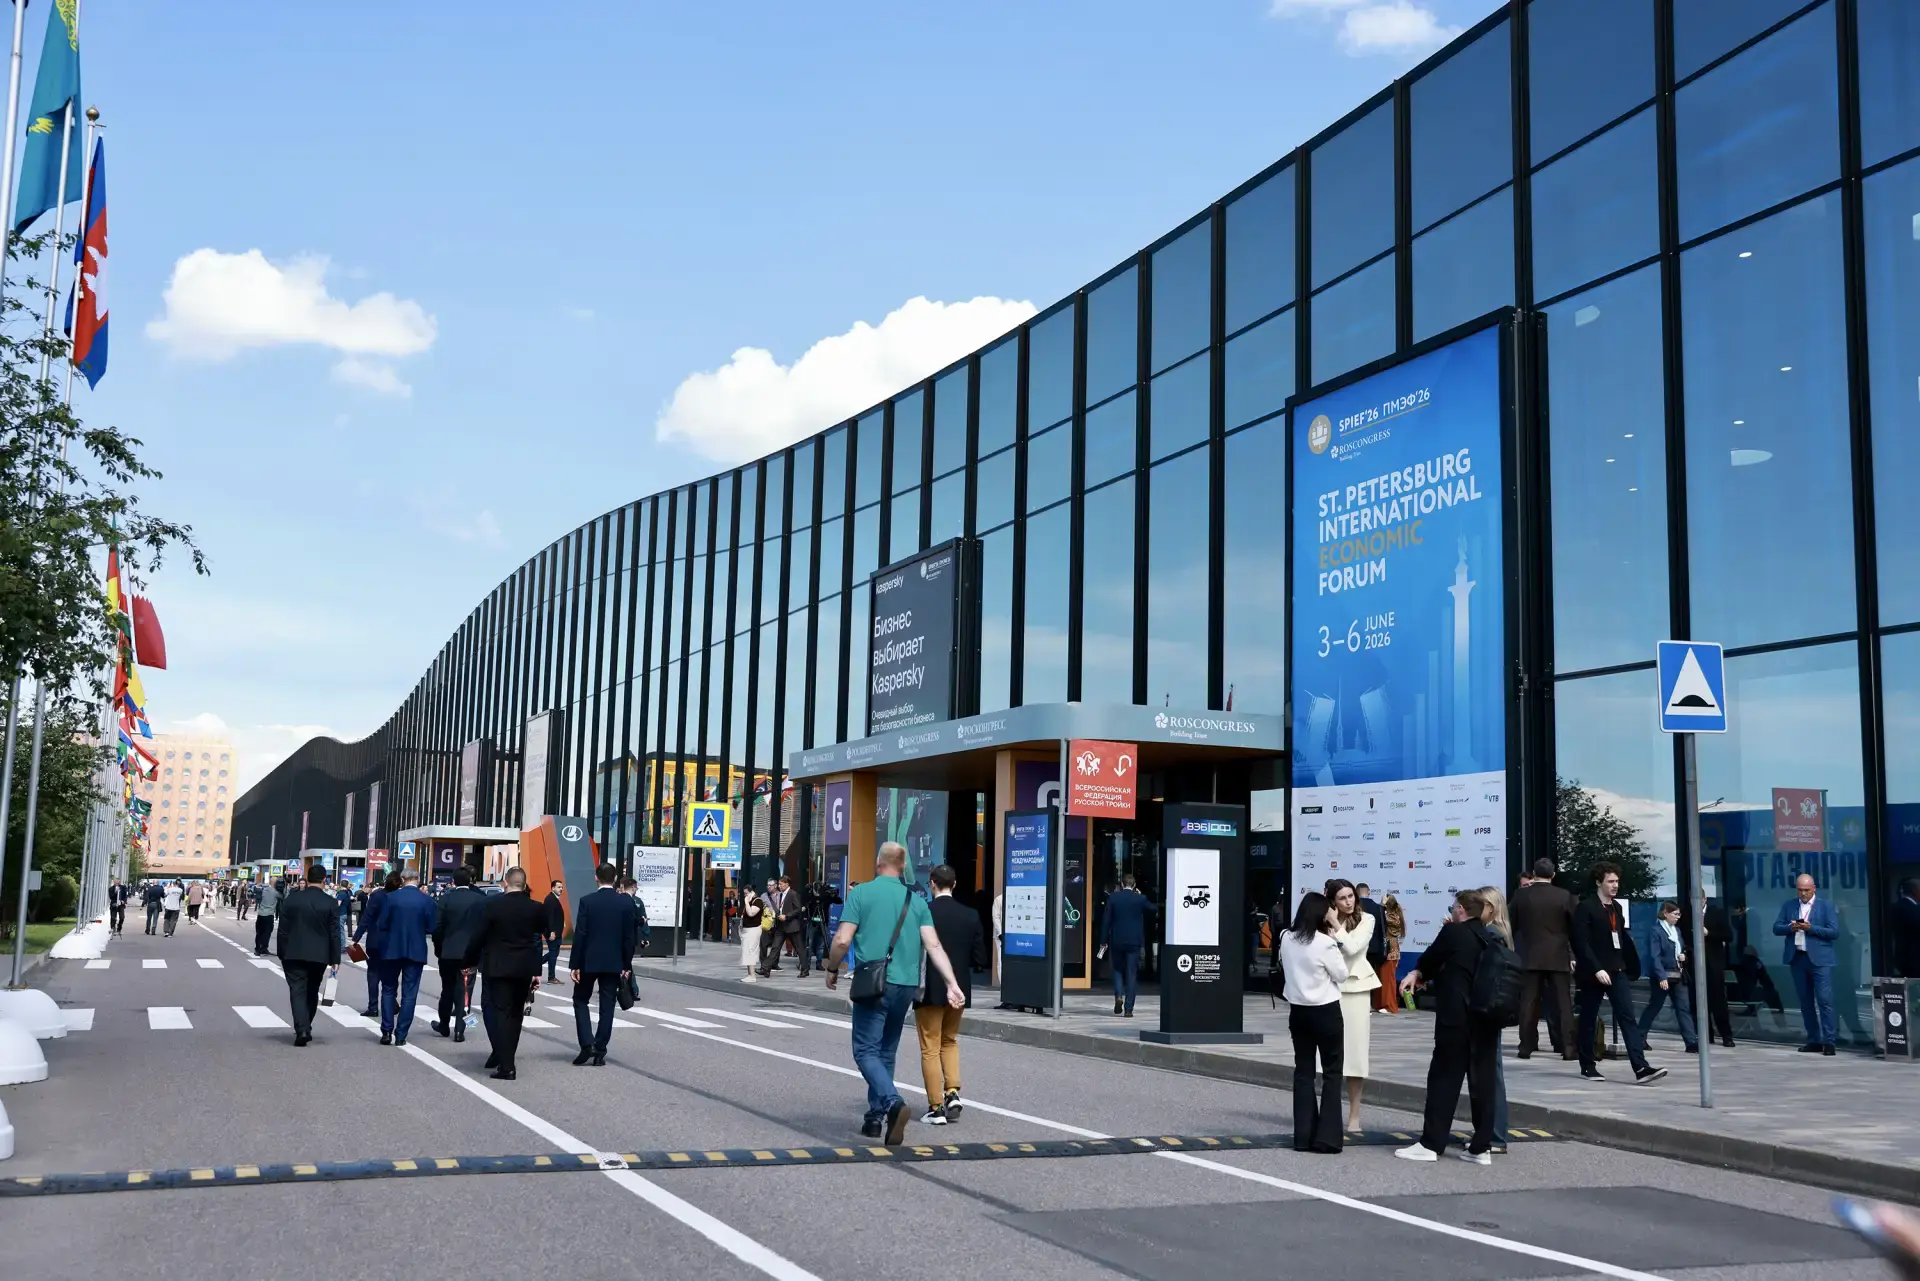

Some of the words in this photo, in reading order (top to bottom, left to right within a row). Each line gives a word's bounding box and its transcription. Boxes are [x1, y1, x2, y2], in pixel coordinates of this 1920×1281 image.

[1339, 428, 1391, 454] ROSCONGRESS
[1318, 490, 1342, 517] ST.
[1346, 447, 1471, 510] PETERSBURG
[1319, 475, 1482, 544] INTERNATIONAL
[1319, 520, 1424, 569] ECONOMIC
[876, 574, 904, 595] kaspersky
[1319, 557, 1386, 596] FORUM
[874, 610, 912, 638] Бизнес
[1364, 611, 1395, 632] JUNE
[873, 635, 925, 667] выбирает
[1364, 632, 1391, 650] 2026
[872, 663, 925, 697] Kaspersky
[872, 703, 898, 721] Очевидный
[898, 702, 914, 716] выбор
[871, 723, 880, 734] для
[880, 715, 913, 731] безопасности
[914, 711, 935, 725] бизнеса
[964, 718, 1007, 736] РОСКОНГРЕСС
[1170, 716, 1255, 733] ROSCONGRESS
[1075, 784, 1131, 794] ВСЕРОССИЙСКАЯ
[1084, 792, 1122, 801] ФЕДЕРАЦИЯ
[832, 797, 843, 831] G
[1074, 799, 1104, 807] РУССКОЙ
[1105, 800, 1131, 809] ТРОЙКИ
[1480, 827, 1491, 835] PSB
[441, 848, 454, 863] G
